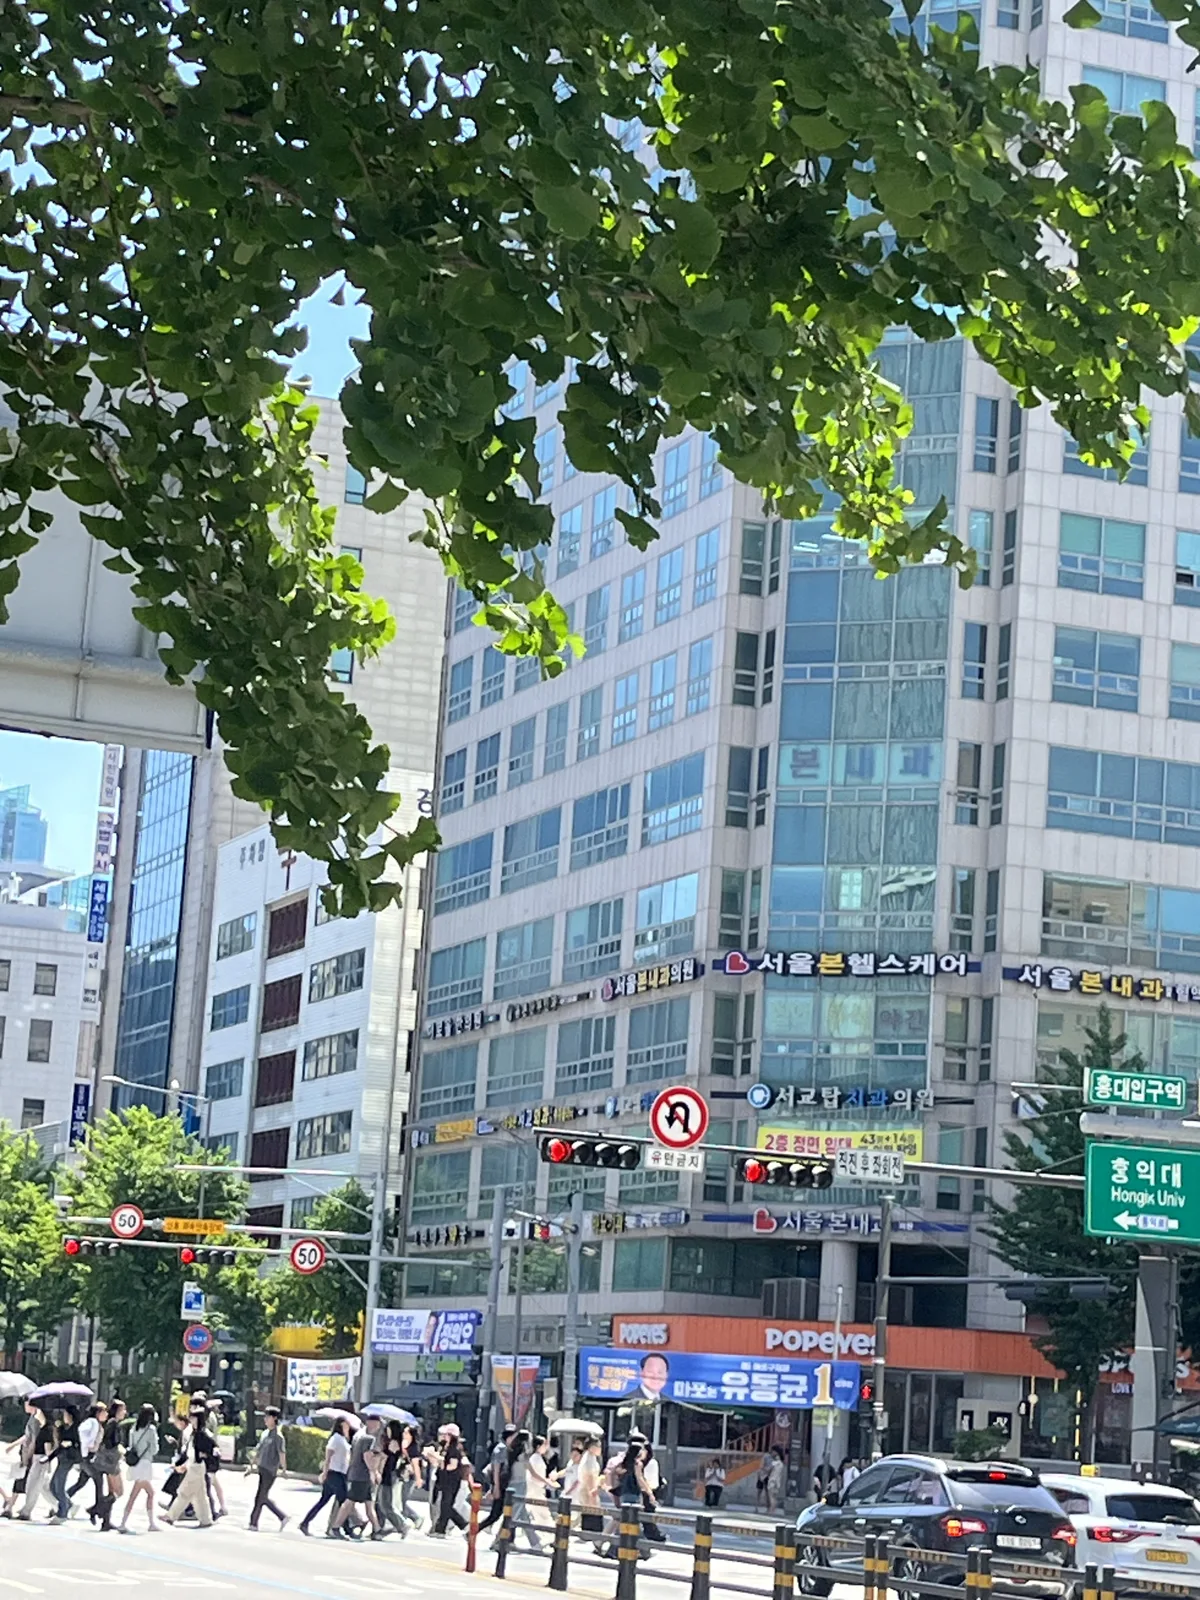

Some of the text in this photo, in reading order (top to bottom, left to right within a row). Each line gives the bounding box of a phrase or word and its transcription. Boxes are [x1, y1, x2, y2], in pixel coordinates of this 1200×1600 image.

[757, 952, 968, 976] 서울본헬스케어
[614, 957, 696, 996] 서울본내과의원
[1018, 964, 1164, 1001] 서울본내과
[1094, 1074, 1182, 1106] 홍대입구역
[765, 1134, 788, 1152] 2층
[651, 1150, 699, 1168] 유턴금지
[1111, 1185, 1186, 1209] Hongik Univ
[118, 1213, 137, 1228] 50
[297, 1247, 318, 1265] 50
[720, 1371, 809, 1405] 유동균
[811, 1362, 834, 1406] 1
